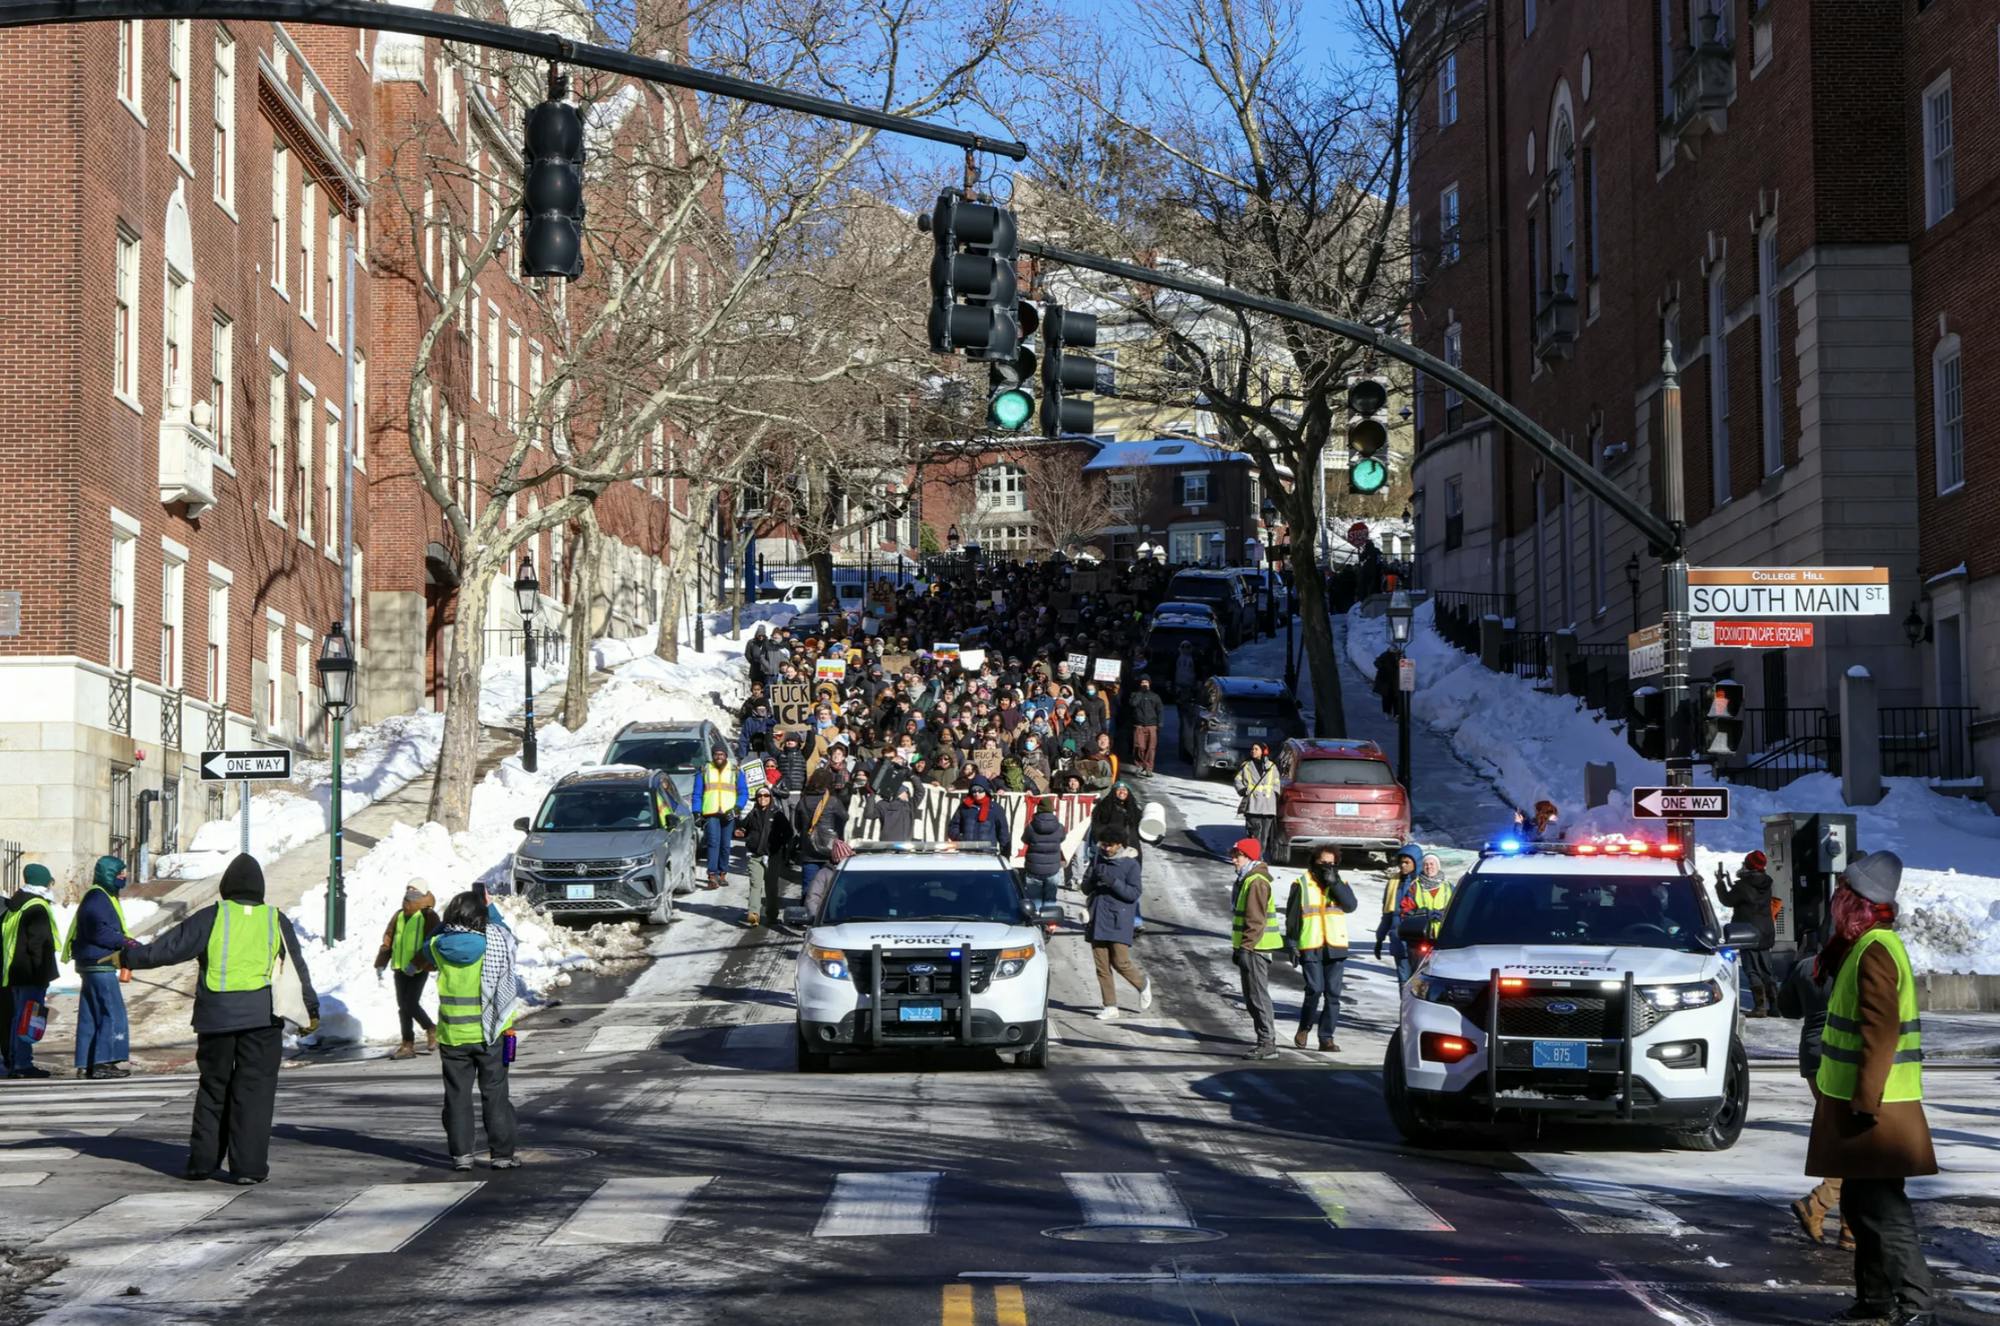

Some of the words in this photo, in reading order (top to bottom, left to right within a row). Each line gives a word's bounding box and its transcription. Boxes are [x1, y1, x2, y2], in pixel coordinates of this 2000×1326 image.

[1752, 571, 1796, 580] COLLEGE
[1803, 571, 1824, 580] HILL
[1694, 588, 1785, 613] SOUTH
[1795, 588, 1859, 612] MAIN
[1865, 588, 1885, 600] ST.
[1715, 627, 1758, 641] TOCKWOTTON
[1759, 627, 1775, 641] CAPE
[1776, 627, 1804, 642] VERDEAN
[1070, 654, 1085, 664] ICE
[771, 686, 809, 703] FUCK
[773, 704, 809, 725] ICE
[975, 751, 999, 760] FUCK
[227, 759, 251, 771] ONE
[255, 759, 281, 770] WAY
[1661, 797, 1687, 809] ONE
[1691, 797, 1718, 809] WAY
[1553, 1048, 1570, 1061] 875
